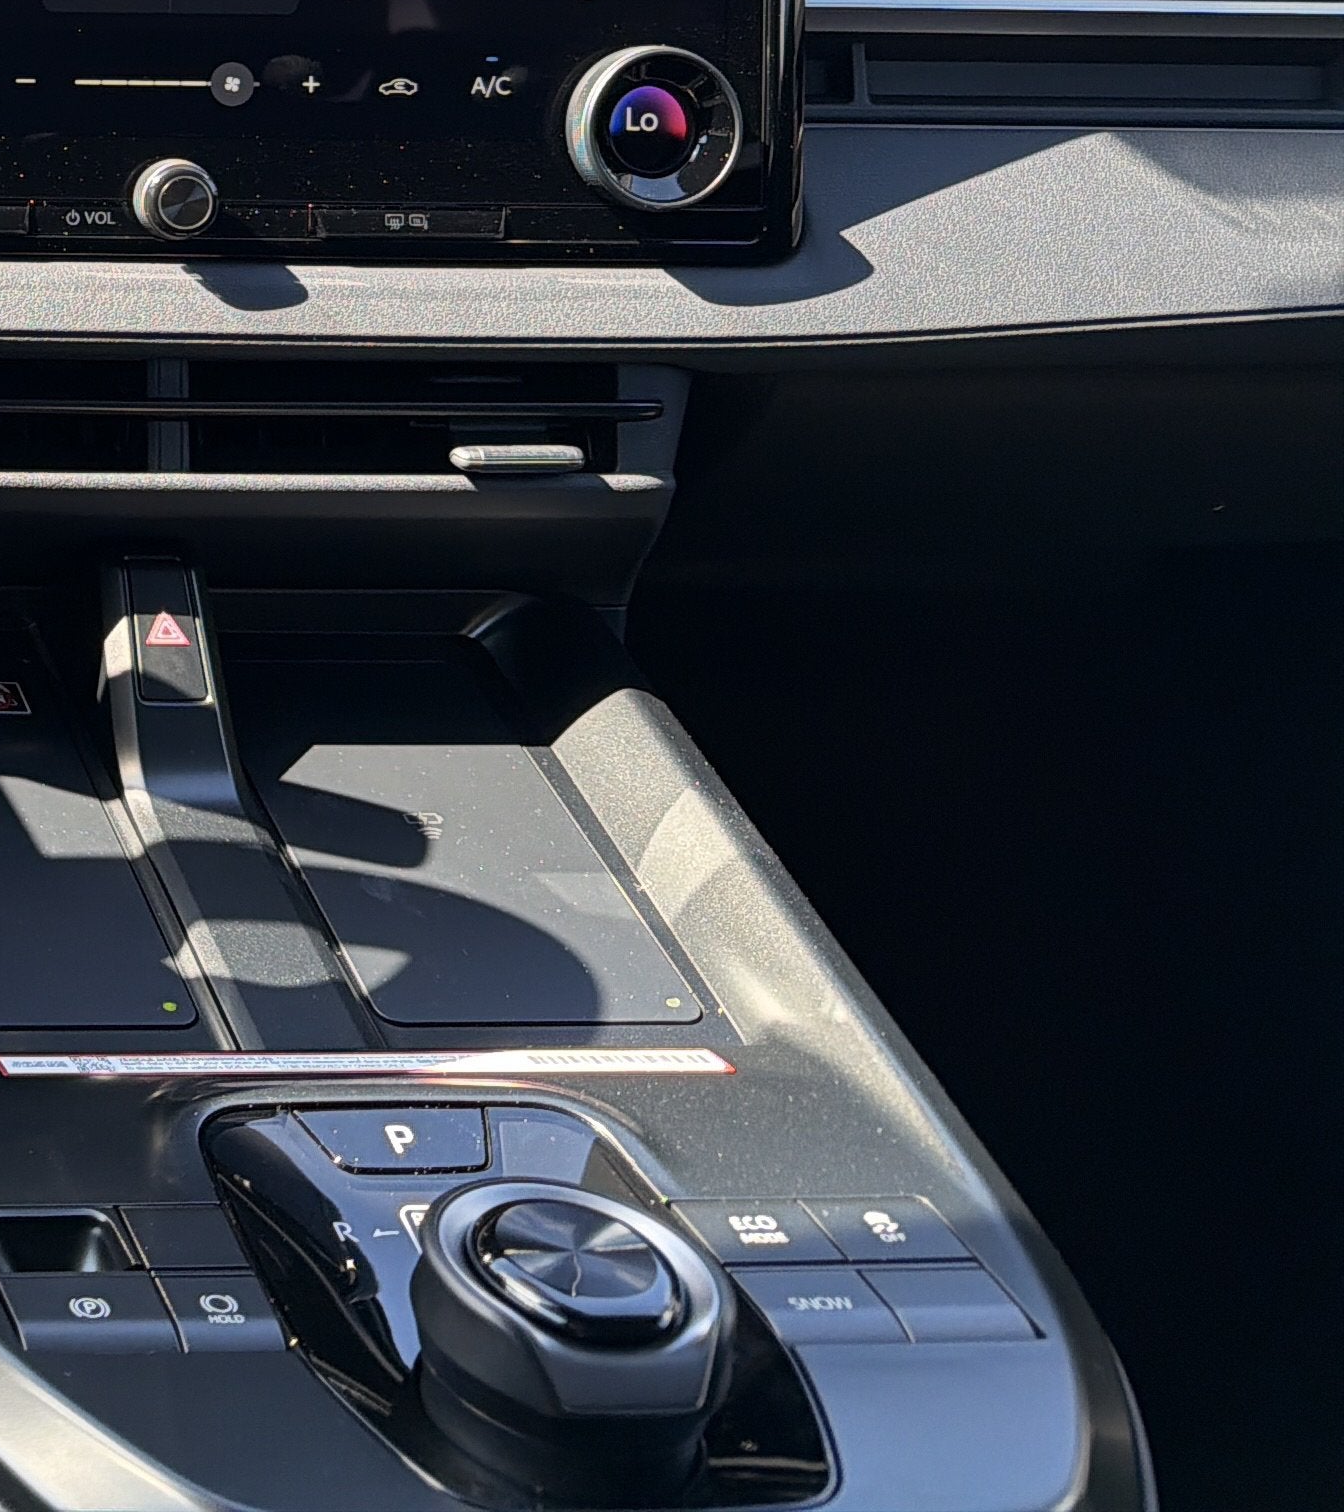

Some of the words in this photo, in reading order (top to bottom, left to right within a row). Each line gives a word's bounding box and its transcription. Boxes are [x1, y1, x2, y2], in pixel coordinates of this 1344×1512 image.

[471, 76, 512, 98] A/C
[626, 107, 658, 132] Lo
[84, 211, 116, 225] VOL
[385, 1124, 414, 1154] P
[333, 1221, 360, 1243] R
[728, 1214, 778, 1231] ECO
[788, 1296, 853, 1311] SNOW
[208, 1314, 245, 1324] HOLD
